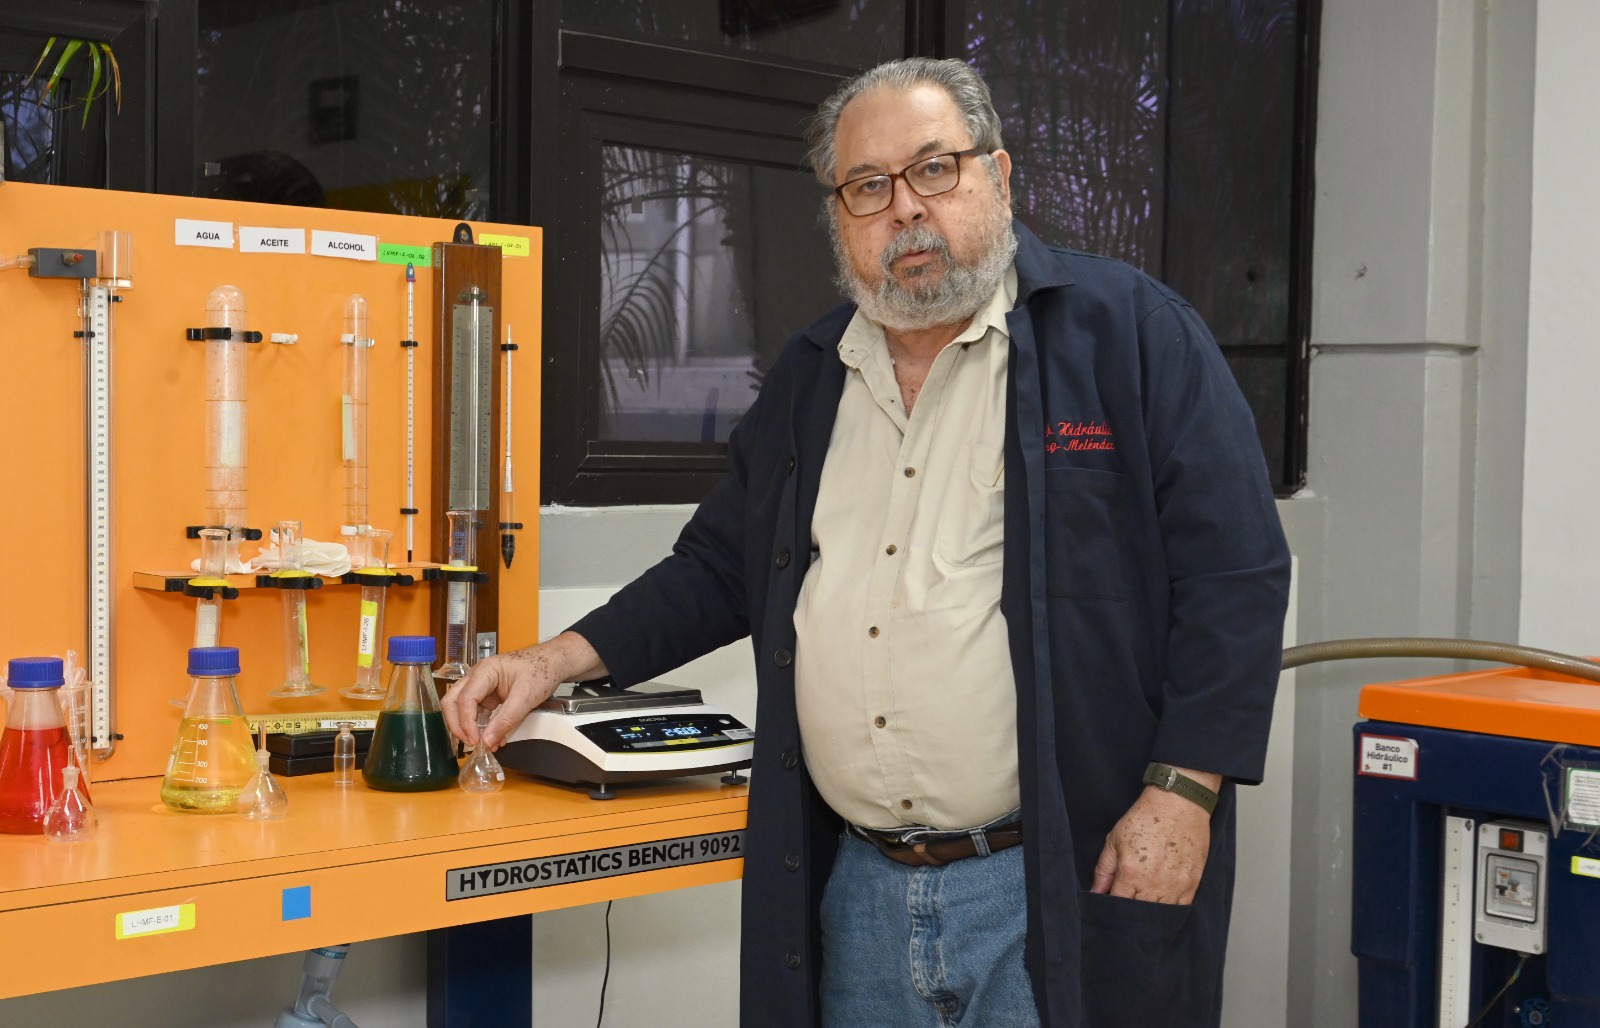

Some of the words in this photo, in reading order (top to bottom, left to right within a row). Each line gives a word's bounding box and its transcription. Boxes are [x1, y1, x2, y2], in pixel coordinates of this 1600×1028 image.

[196, 232, 220, 240] AGUA
[260, 239, 289, 247] ACEITE
[328, 241, 365, 251] ALCOHOL
[1375, 742, 1401, 753] Banco
[1366, 751, 1409, 763] Hidráulico
[1382, 763, 1393, 771] #1
[460, 851, 623, 892] HYDROSTATICS
[628, 840, 695, 868] BENCH
[700, 834, 741, 856] 9092
[131, 914, 173, 928] LHMF-E-01
